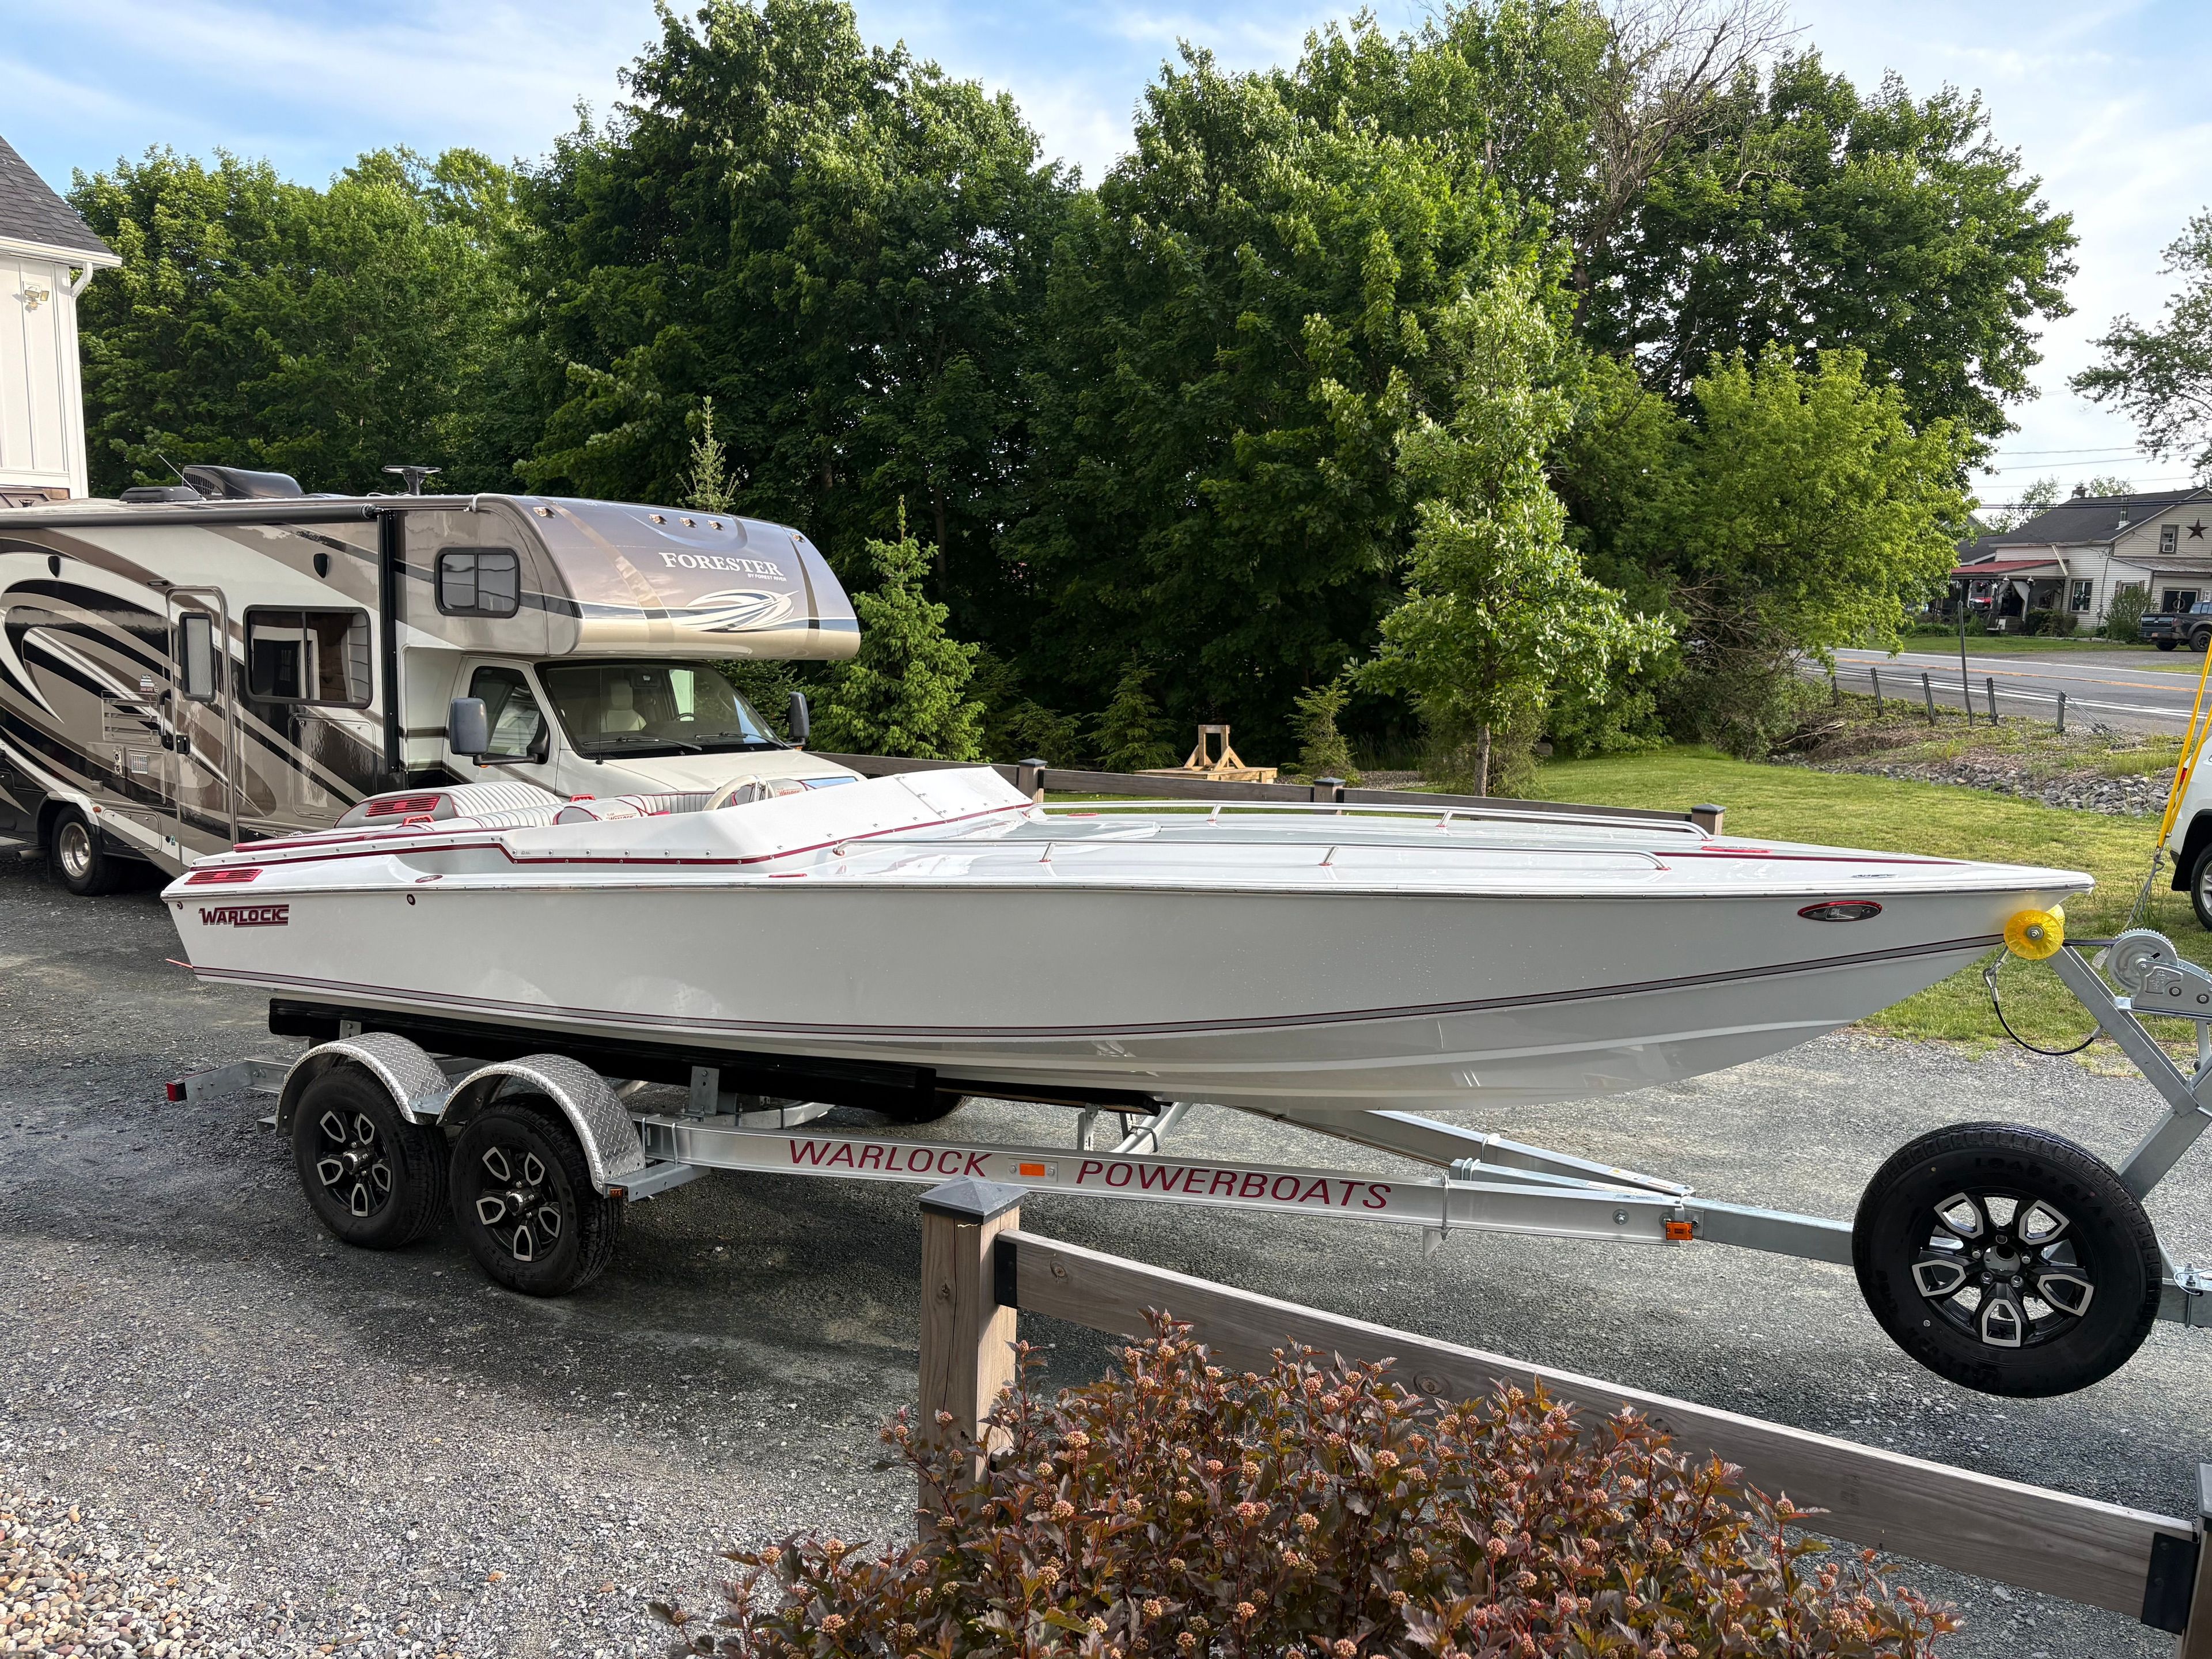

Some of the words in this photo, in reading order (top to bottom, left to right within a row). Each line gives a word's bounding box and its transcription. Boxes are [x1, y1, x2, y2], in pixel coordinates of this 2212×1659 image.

[658, 552, 784, 577] FORESTER
[198, 904, 289, 928] WARLOCK
[790, 1139, 993, 1177] WARLOCK
[1076, 1161, 1391, 1209] POWERBOATS
